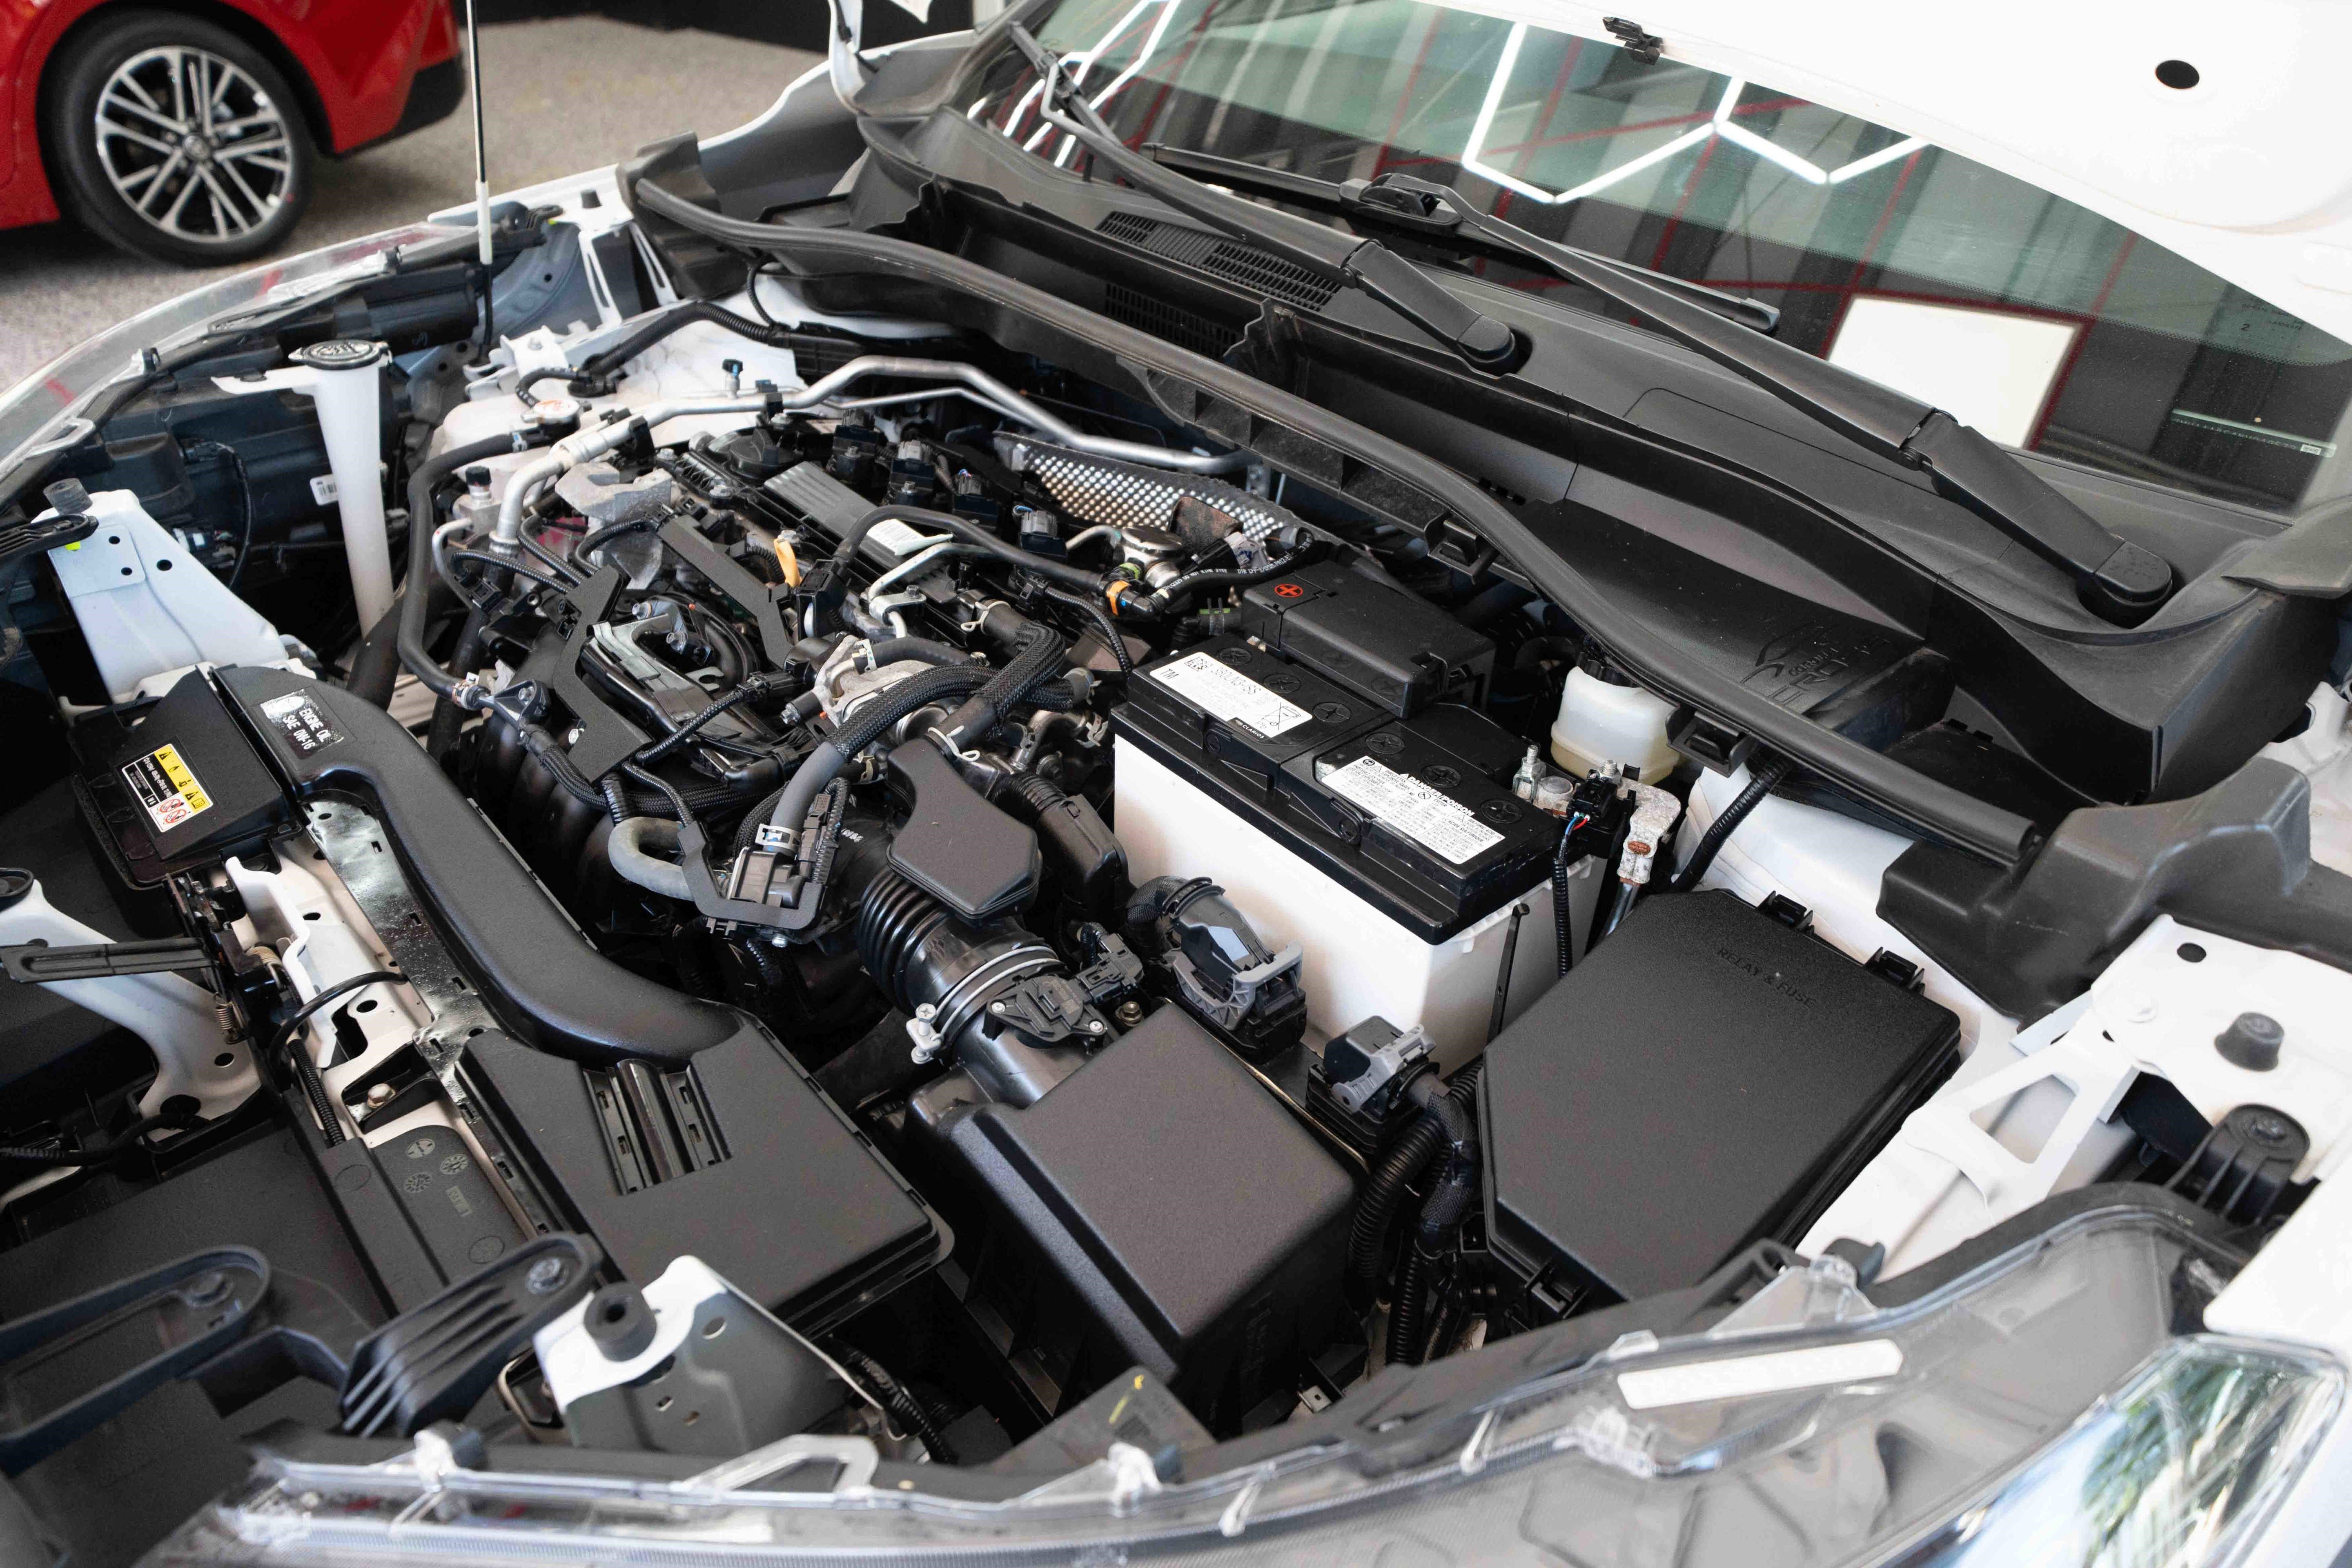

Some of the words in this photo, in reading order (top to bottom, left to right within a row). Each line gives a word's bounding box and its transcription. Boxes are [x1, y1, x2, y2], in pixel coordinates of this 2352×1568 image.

[2241, 323, 2250, 332] 2
[1160, 668, 1179, 679] TM
[283, 715, 301, 730] SAE
[294, 729, 316, 750] 0W-16
[299, 708, 323, 732] ENGINE
[316, 729, 331, 742] OIL
[1242, 723, 1265, 739] CLARIOS
[1407, 776, 1476, 816] DANGER/POISON
